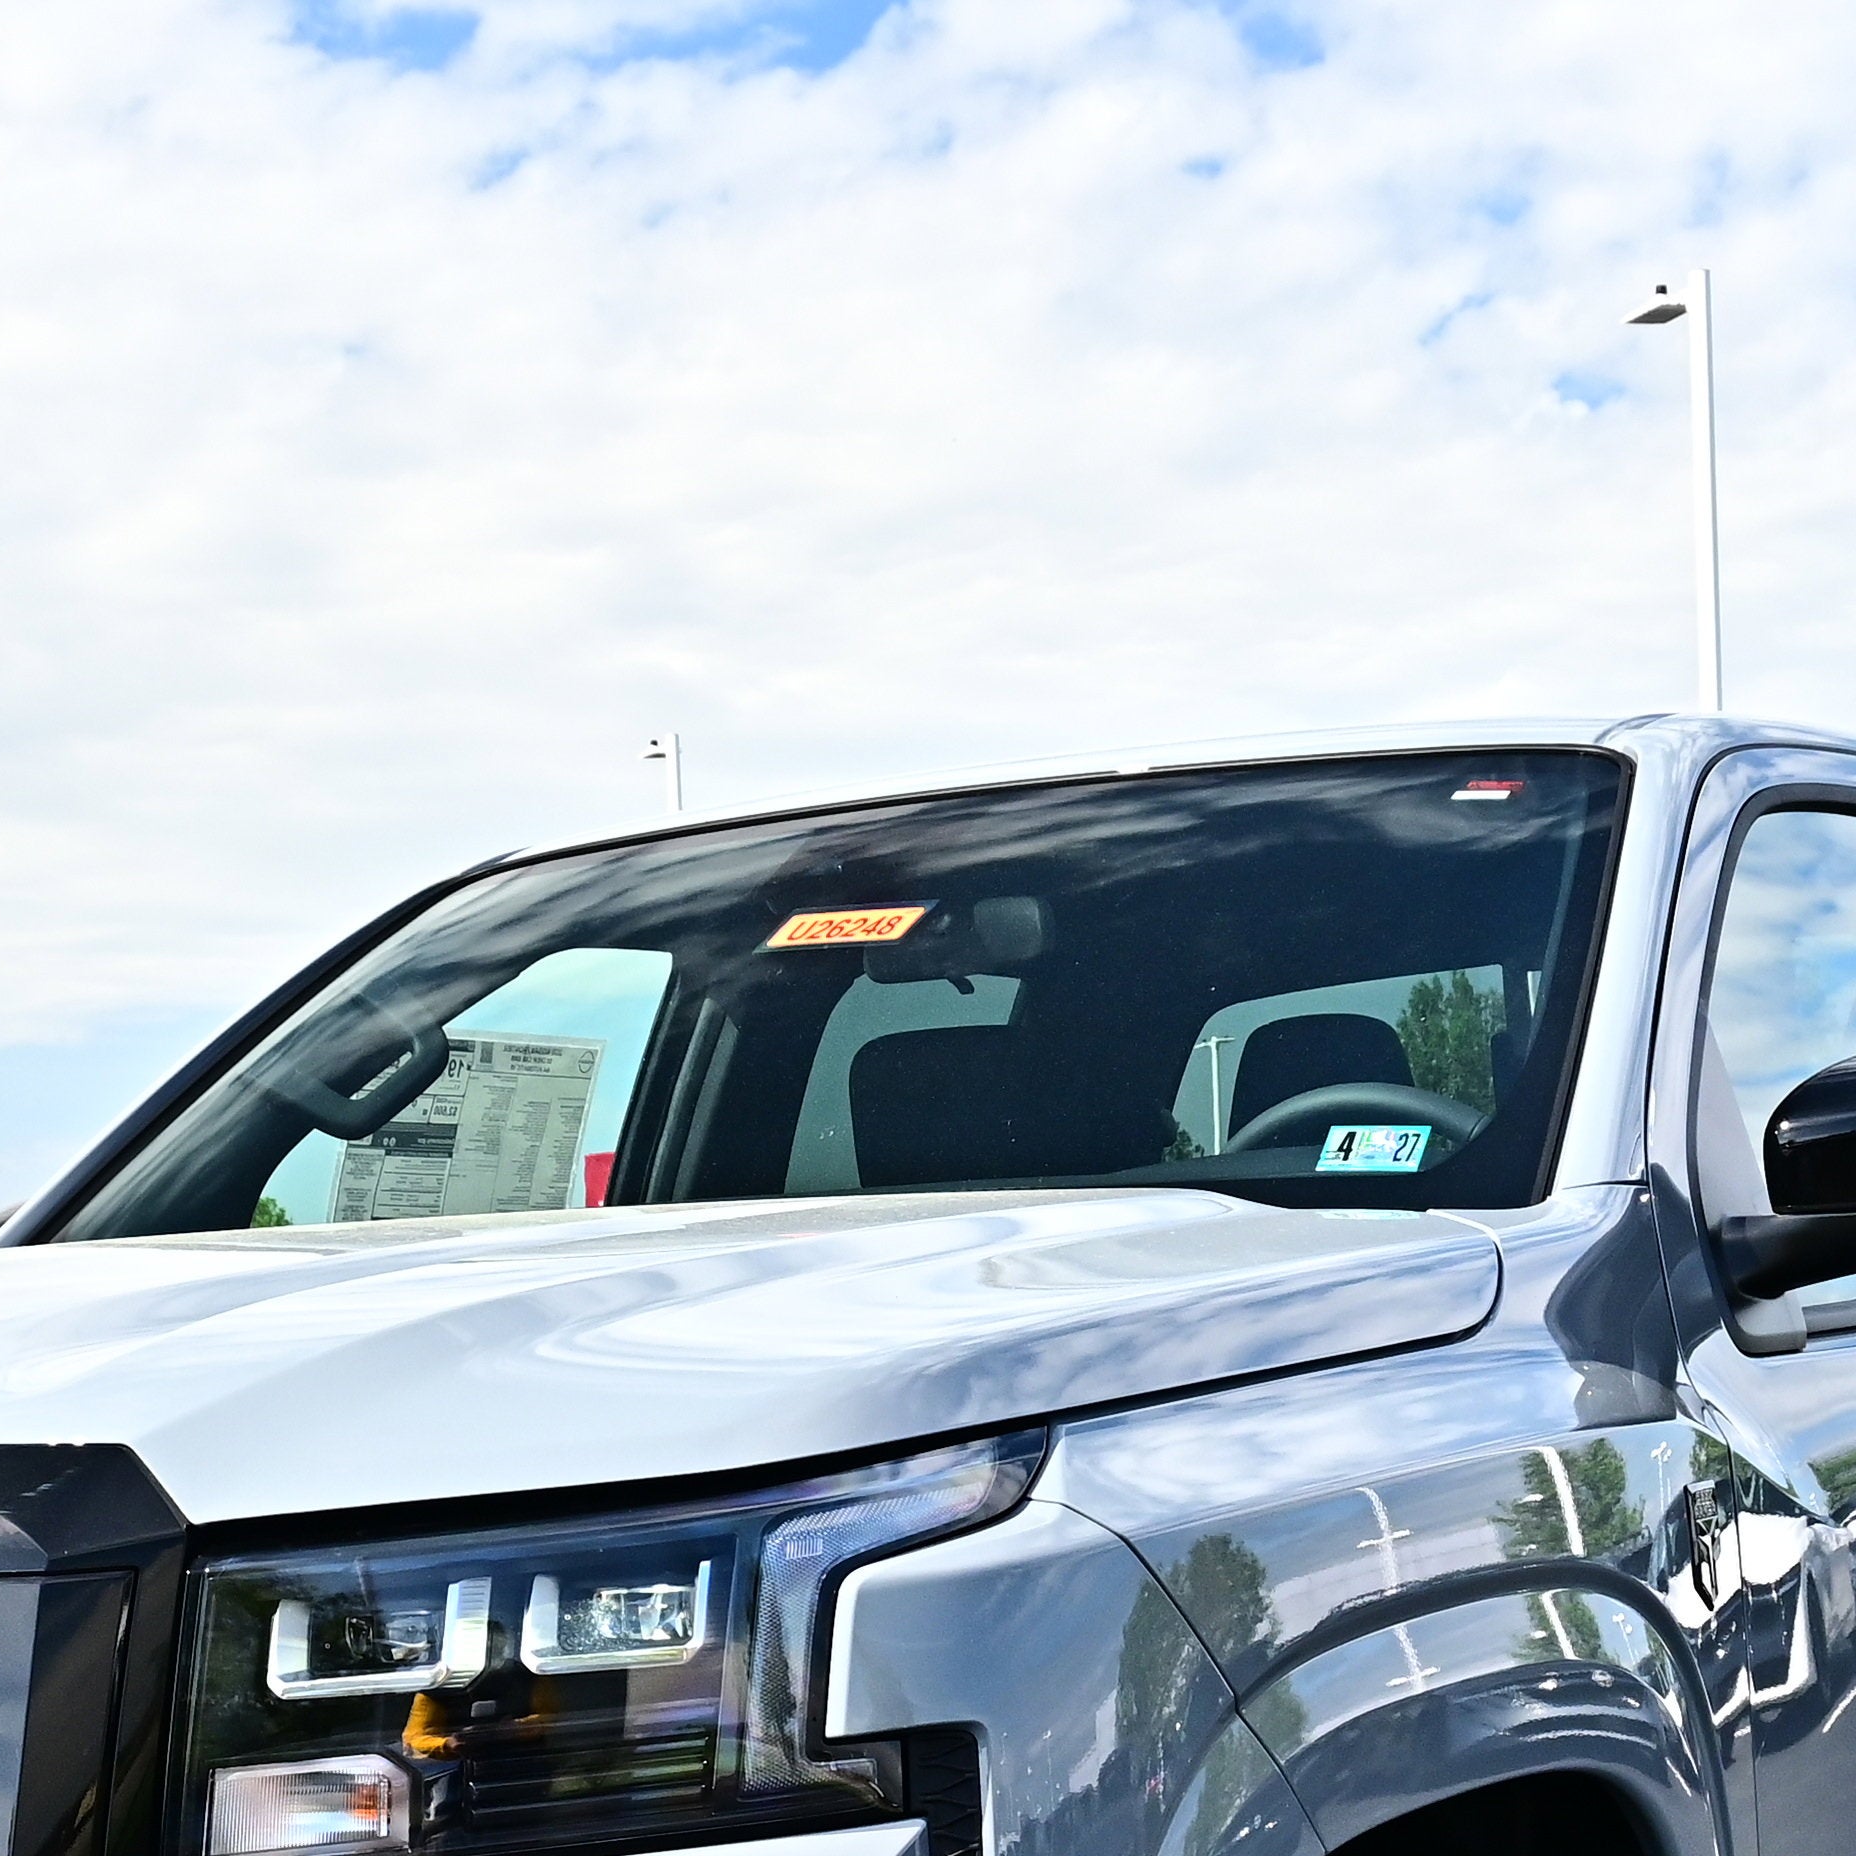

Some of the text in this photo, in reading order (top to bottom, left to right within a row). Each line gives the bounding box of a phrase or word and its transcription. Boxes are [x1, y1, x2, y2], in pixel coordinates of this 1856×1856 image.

[787, 915, 902, 941] U26248
[1337, 1131, 1357, 1161] 4
[1393, 1132, 1421, 1162] 27
